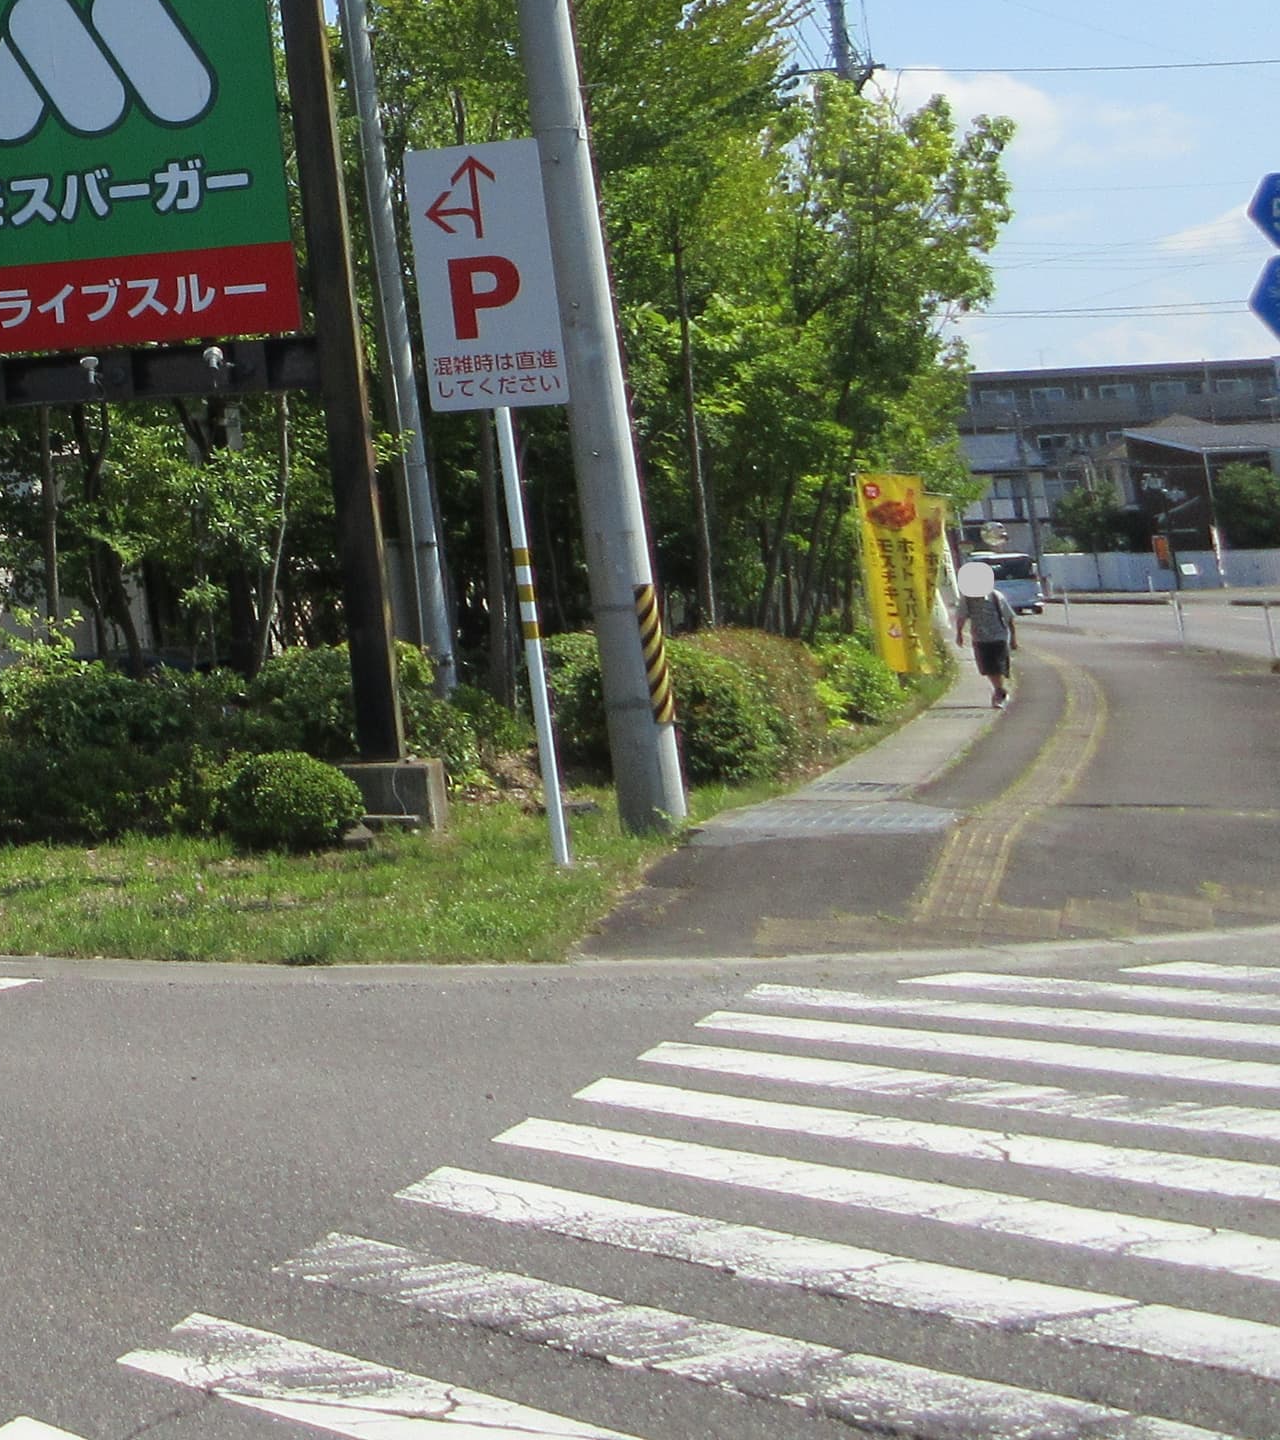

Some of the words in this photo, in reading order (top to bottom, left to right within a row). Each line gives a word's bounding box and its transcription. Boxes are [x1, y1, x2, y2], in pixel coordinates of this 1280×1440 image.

[448, 255, 520, 340] P
[433, 349, 559, 376] 混雑時は直進
[437, 373, 561, 399] してください
